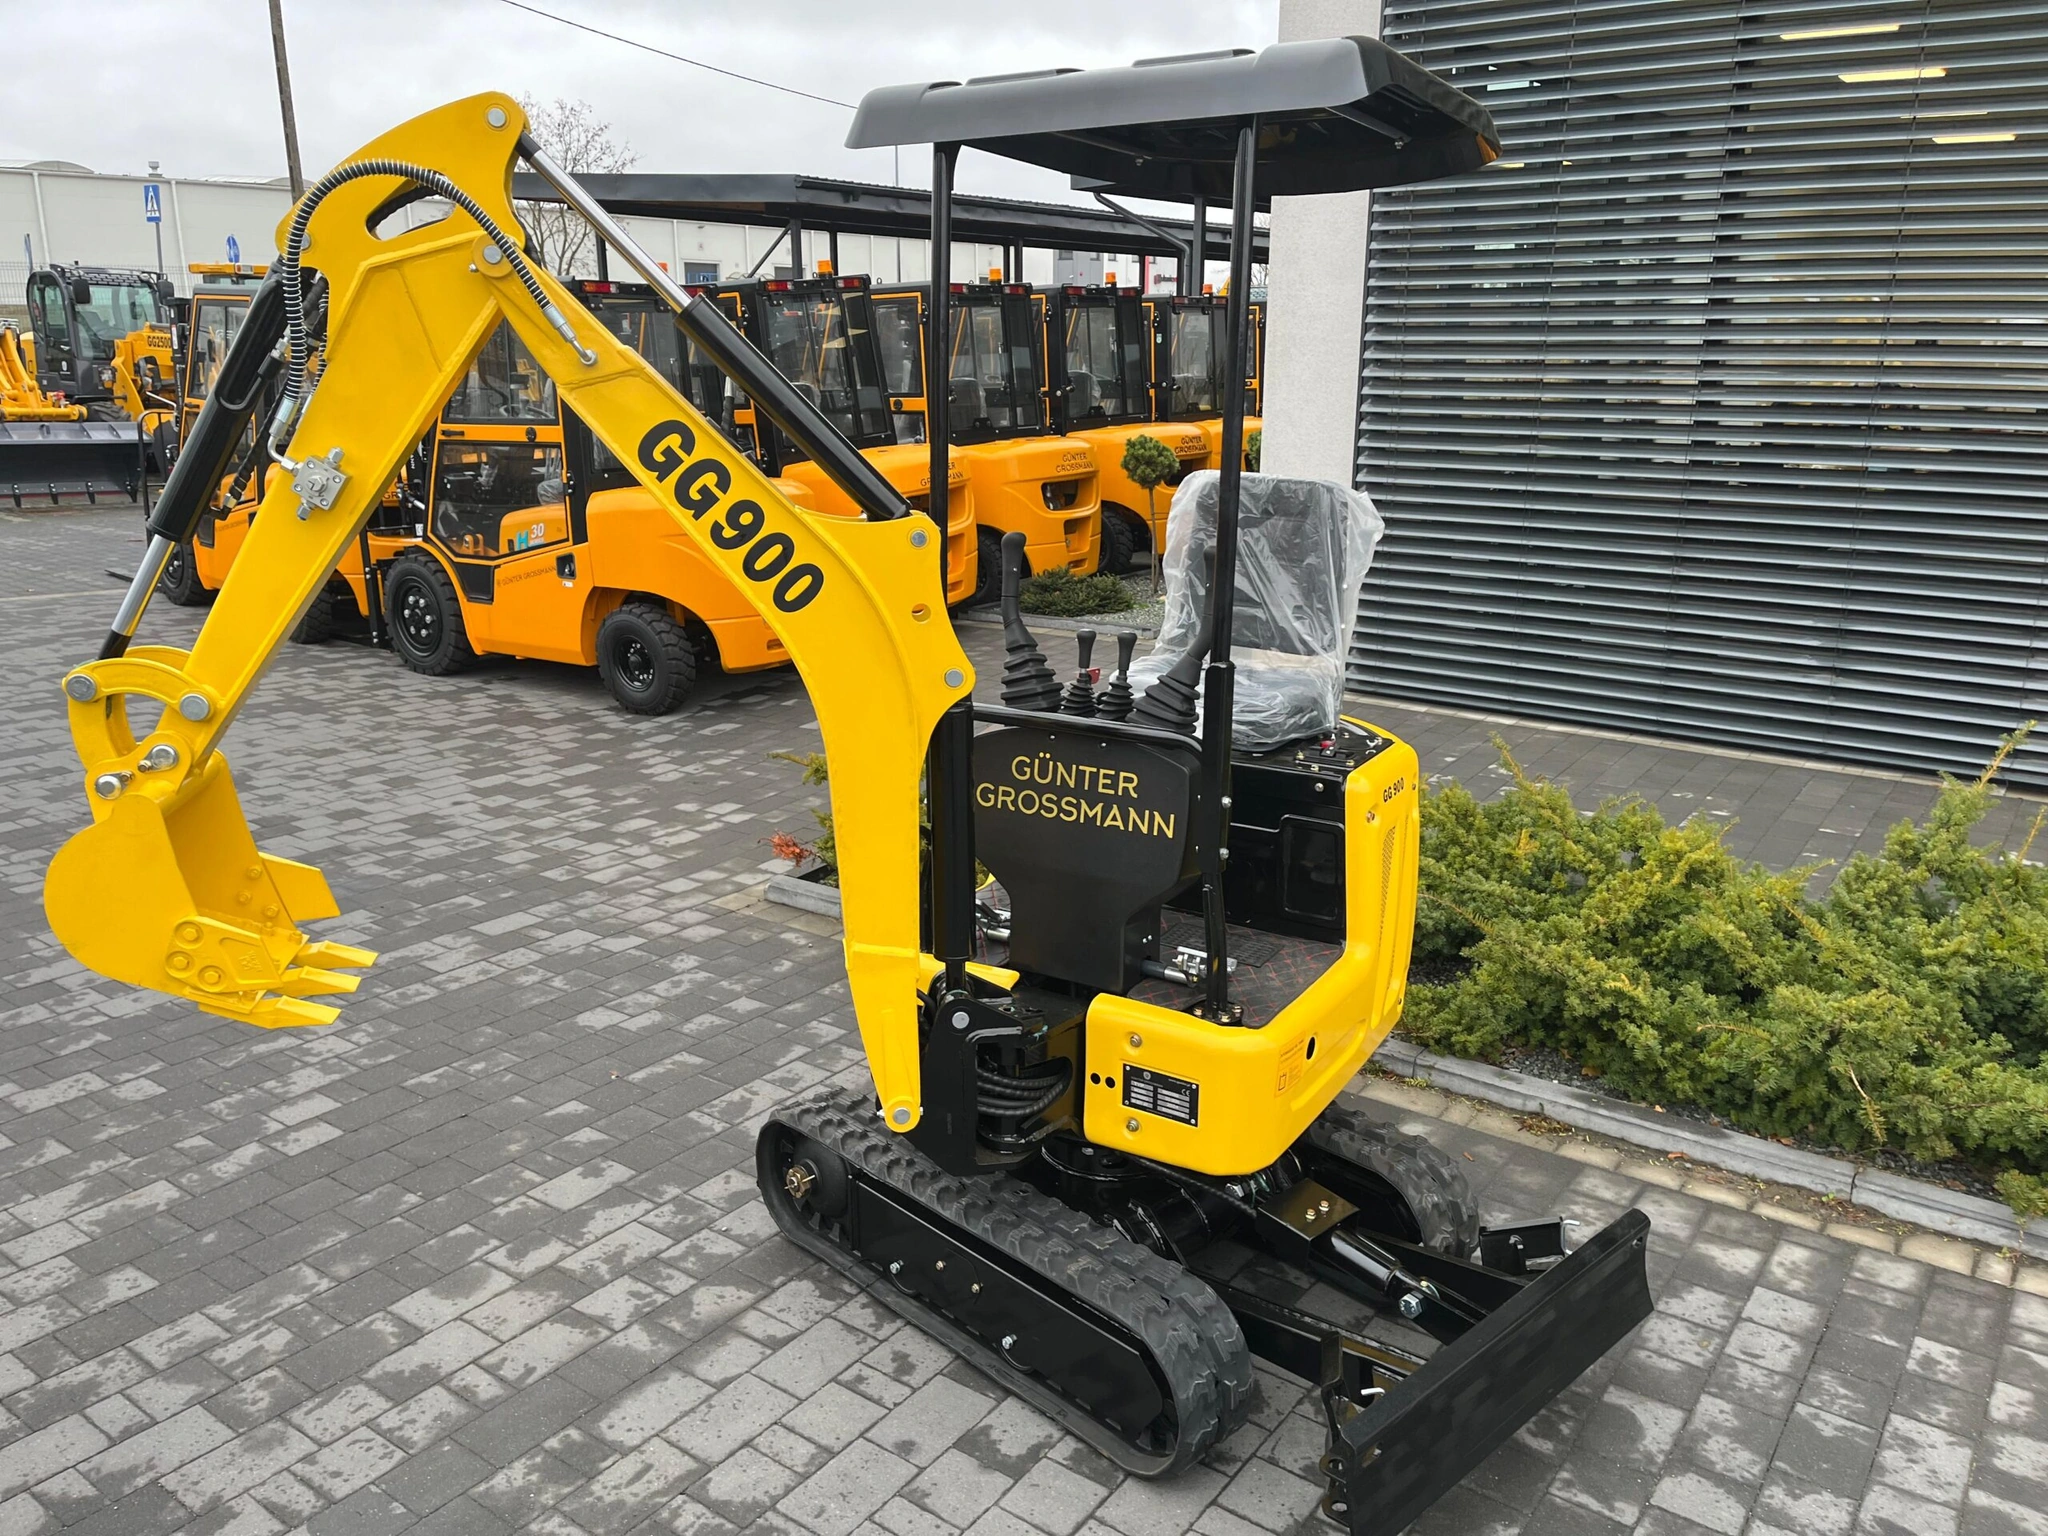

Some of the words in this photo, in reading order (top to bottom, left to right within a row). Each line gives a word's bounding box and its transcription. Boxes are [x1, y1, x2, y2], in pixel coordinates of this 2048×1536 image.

[530, 522, 545, 538] 30
[637, 419, 824, 613] GG900
[1011, 751, 1139, 799] GÜNTER
[1383, 789, 1392, 802] GG
[1393, 777, 1404, 795] 900
[976, 782, 1175, 839] GROSSMANN
